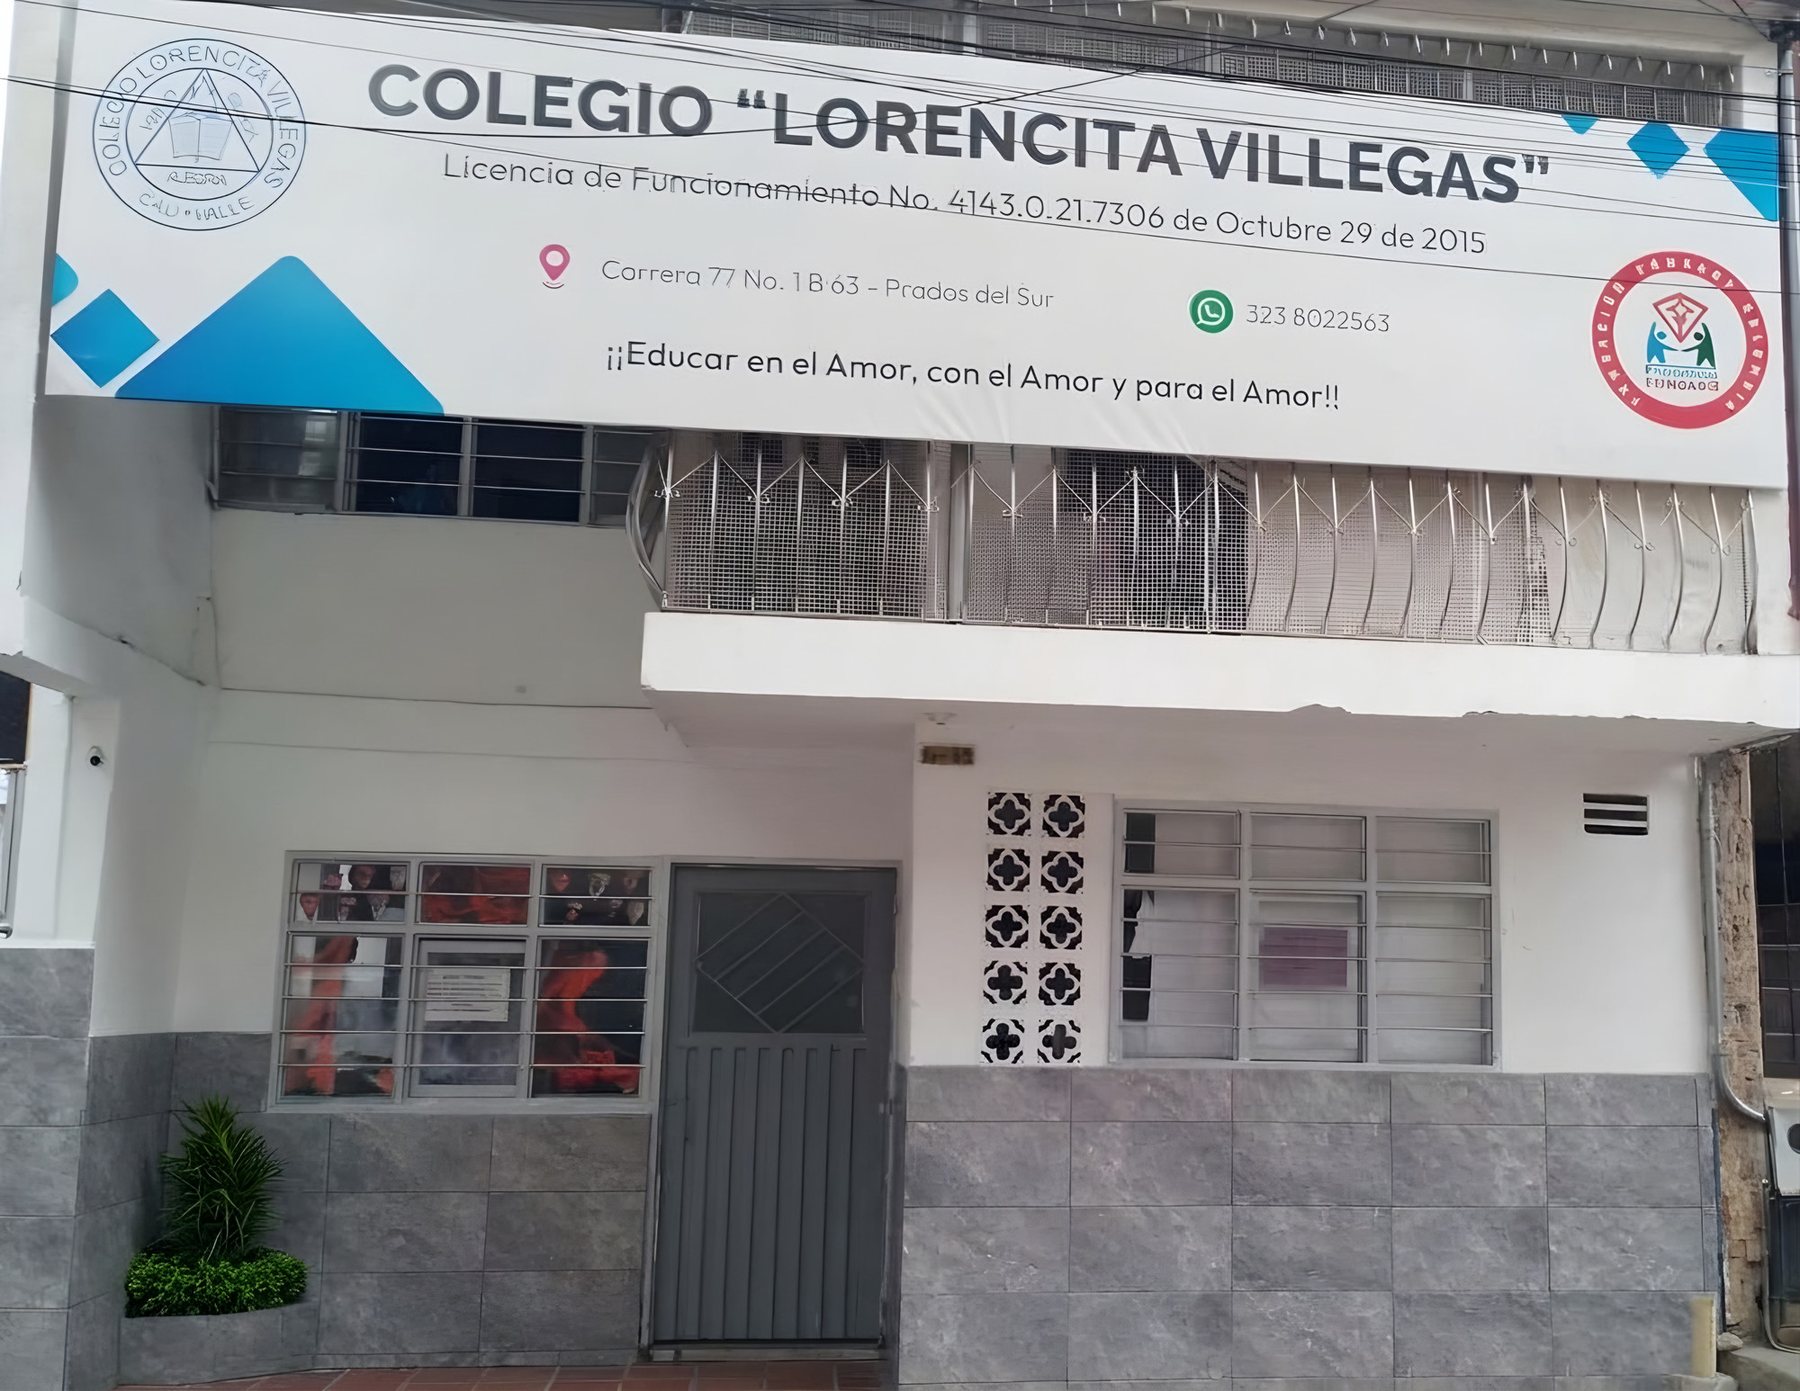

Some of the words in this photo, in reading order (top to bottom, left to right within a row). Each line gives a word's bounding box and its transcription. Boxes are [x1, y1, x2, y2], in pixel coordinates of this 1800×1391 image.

[367, 63, 713, 137] COLEGIO
[737, 88, 1183, 176] “LORENCITA
[444, 153, 573, 185] Licencia
[584, 165, 621, 188] de
[633, 167, 879, 206] Funcionamiento
[890, 186, 938, 210] No.
[949, 190, 1164, 229] 4143.0.21.7306
[1173, 208, 1207, 232] de
[1216, 210, 1332, 242] Octubre
[1340, 220, 1373, 244] 29
[1382, 224, 1414, 249] de
[1422, 228, 1486, 254] 2015
[708, 266, 735, 288] 77
[744, 269, 784, 290] No.
[886, 278, 968, 303] Prados
[976, 284, 1009, 304] del
[1017, 286, 1054, 308] Sur
[1246, 304, 1286, 325] 323
[1293, 307, 1390, 332] 8022563
[607, 341, 738, 371] ¡¡Educar
[747, 355, 783, 374] en
[792, 351, 817, 376] el
[826, 353, 917, 386] Amor,
[927, 365, 979, 385] con
[988, 363, 1012, 388] el
[1020, 365, 1103, 392] Amor
[1112, 378, 1127, 401] y
[1136, 379, 1203, 402] para
[1212, 378, 1235, 402] el
[1242, 380, 1339, 410] Amor!!
